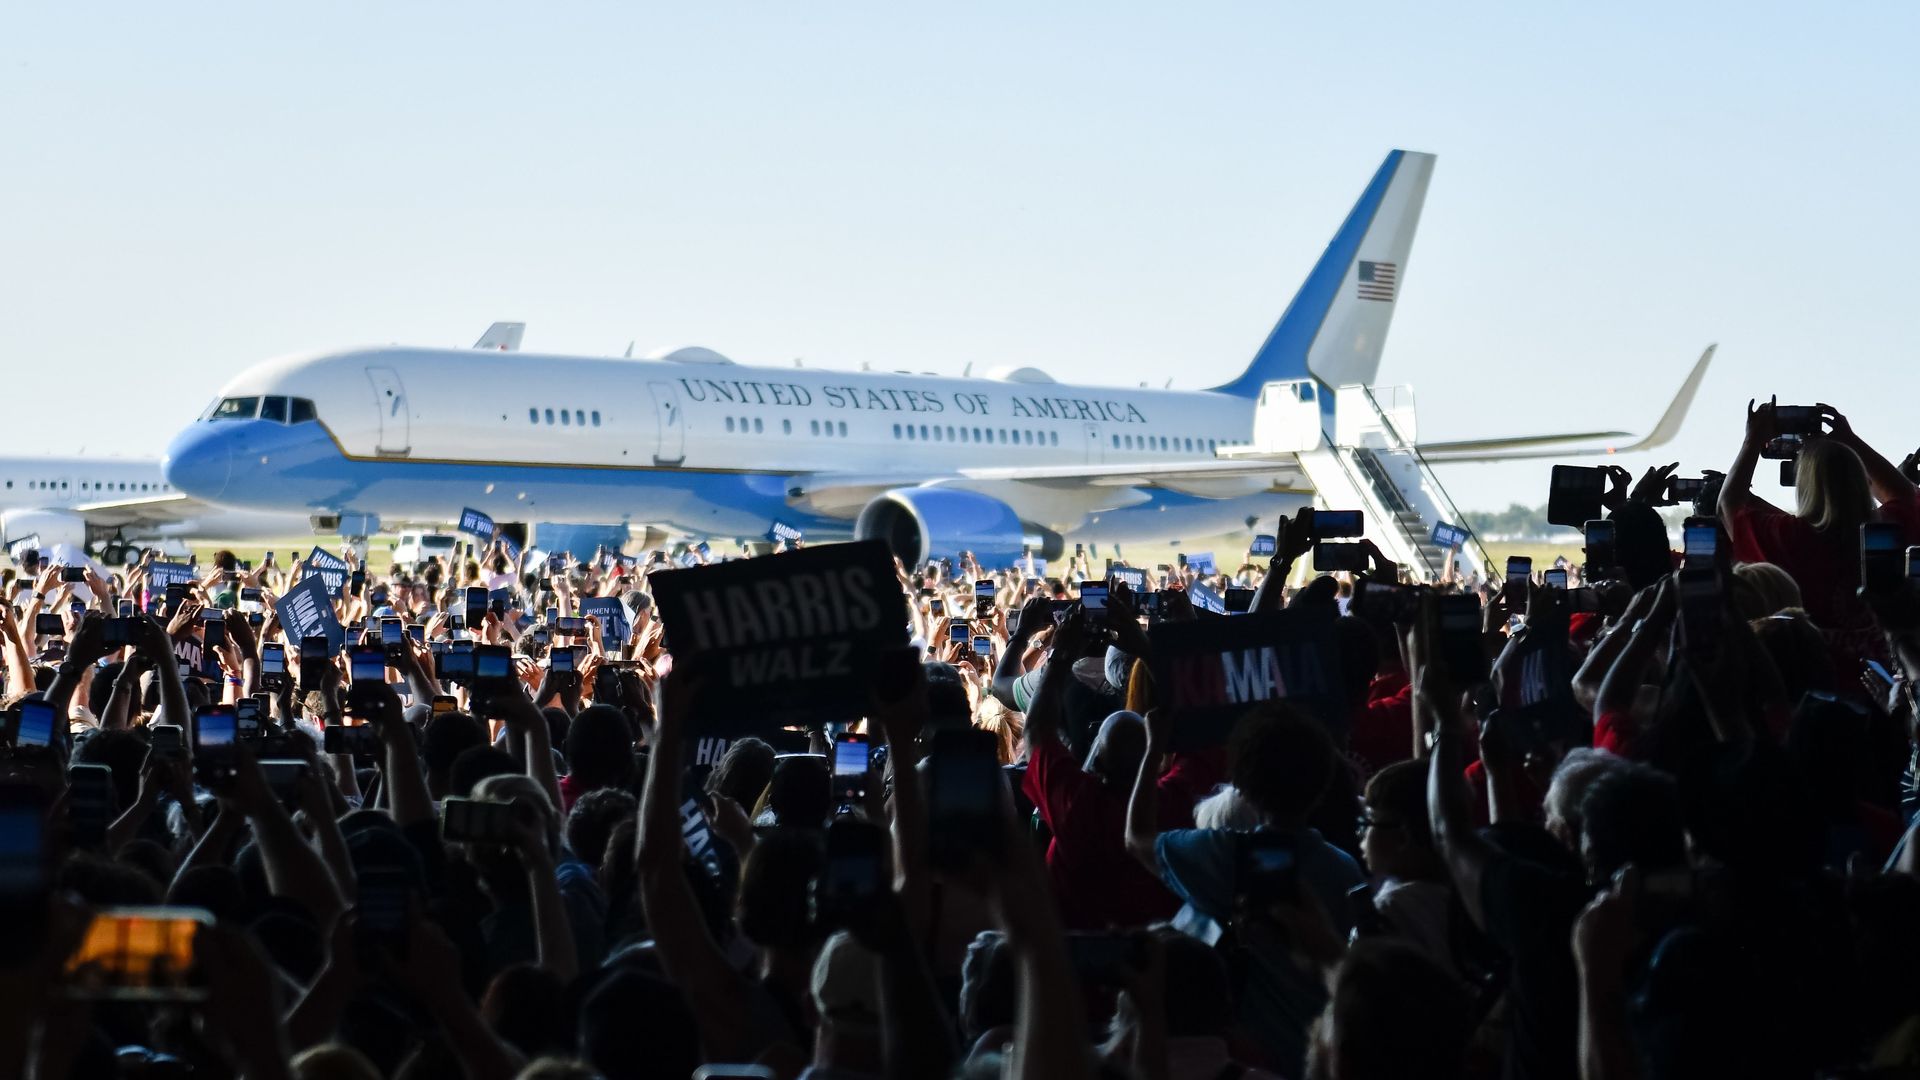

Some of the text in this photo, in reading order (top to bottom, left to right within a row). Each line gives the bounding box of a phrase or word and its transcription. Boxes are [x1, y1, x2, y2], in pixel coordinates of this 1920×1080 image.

[678, 378, 1147, 424] UNITED STATES OF AMERICA
[153, 573, 168, 587] WE
[286, 603, 303, 640] WE FIGHT
[292, 589, 319, 632] WIN
[587, 607, 610, 615] WHEN
[683, 565, 881, 649] HARRIS
[730, 641, 852, 688] WALZ
